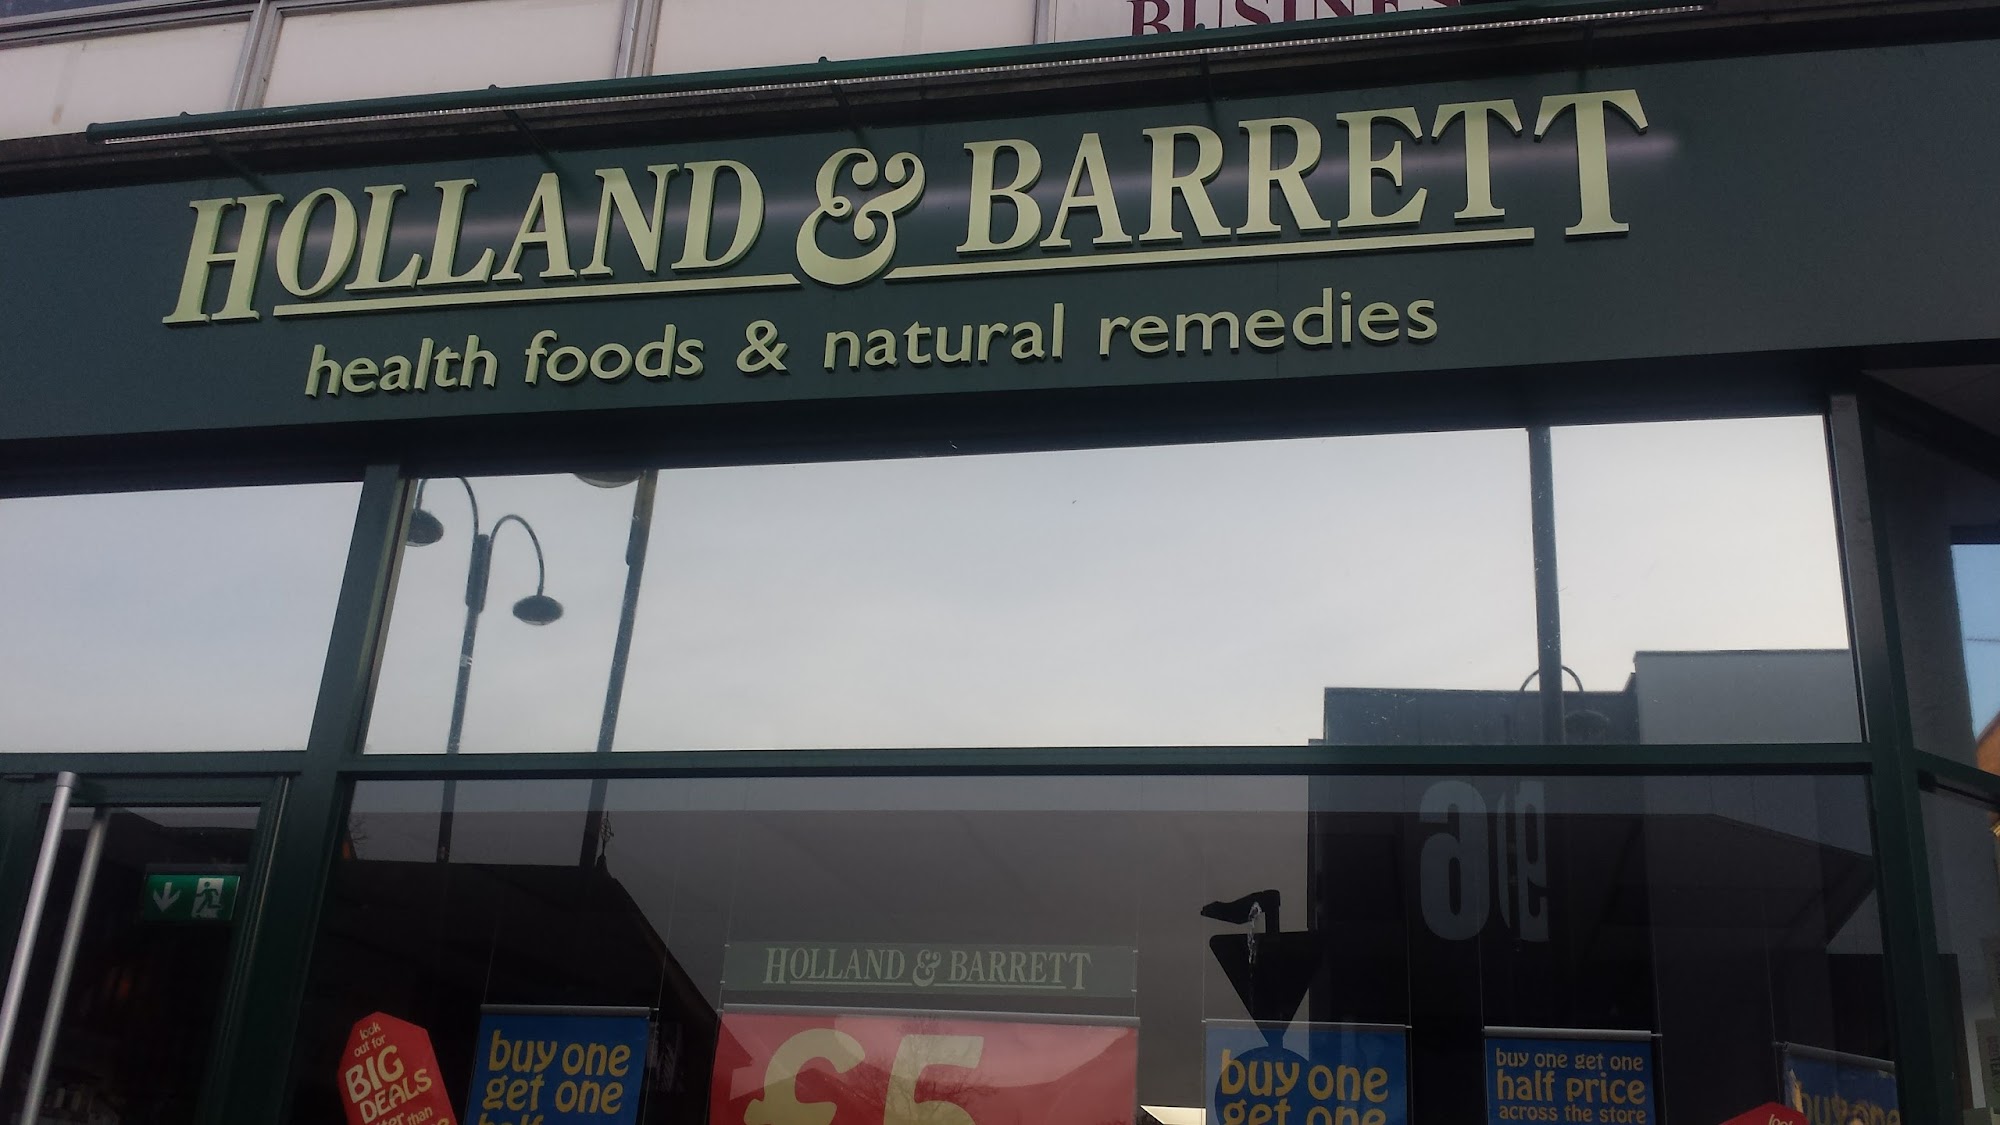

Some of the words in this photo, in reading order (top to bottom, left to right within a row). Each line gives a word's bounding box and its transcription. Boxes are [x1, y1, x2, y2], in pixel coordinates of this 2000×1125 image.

[162, 159, 765, 326] HOLLAND
[796, 147, 926, 286] &
[956, 88, 1650, 257] BARRETT
[303, 333, 498, 397] health
[524, 323, 705, 384] foods
[735, 319, 788, 374] &
[823, 303, 1065, 370] natural
[1099, 287, 1439, 357] remedies
[762, 947, 906, 985] HOLLAND
[912, 948, 942, 987] &
[949, 949, 1092, 990] BARRETT
[353, 1041, 370, 1057] out
[371, 1034, 386, 1048] for
[359, 1021, 381, 1040] look
[488, 1028, 558, 1073] buy
[561, 1042, 631, 1077] one
[1495, 1047, 1529, 1067] buy
[1534, 1052, 1568, 1068] one
[1574, 1052, 1604, 1070] get
[1610, 1055, 1643, 1071] one
[345, 1045, 404, 1103] BIG
[482, 1073, 545, 1110] get
[555, 1080, 624, 1115] one
[744, 1027, 985, 1125] £5
[1220, 1048, 1300, 1097] buy
[1307, 1064, 1389, 1103] one
[1496, 1068, 1555, 1102] half
[1566, 1071, 1646, 1105] price
[359, 1068, 432, 1124] DEALS
[407, 1106, 433, 1125] than
[1223, 1098, 1291, 1125] get
[1499, 1105, 1558, 1121] across
[1564, 1103, 1593, 1123] the
[1599, 1106, 1647, 1124] store
